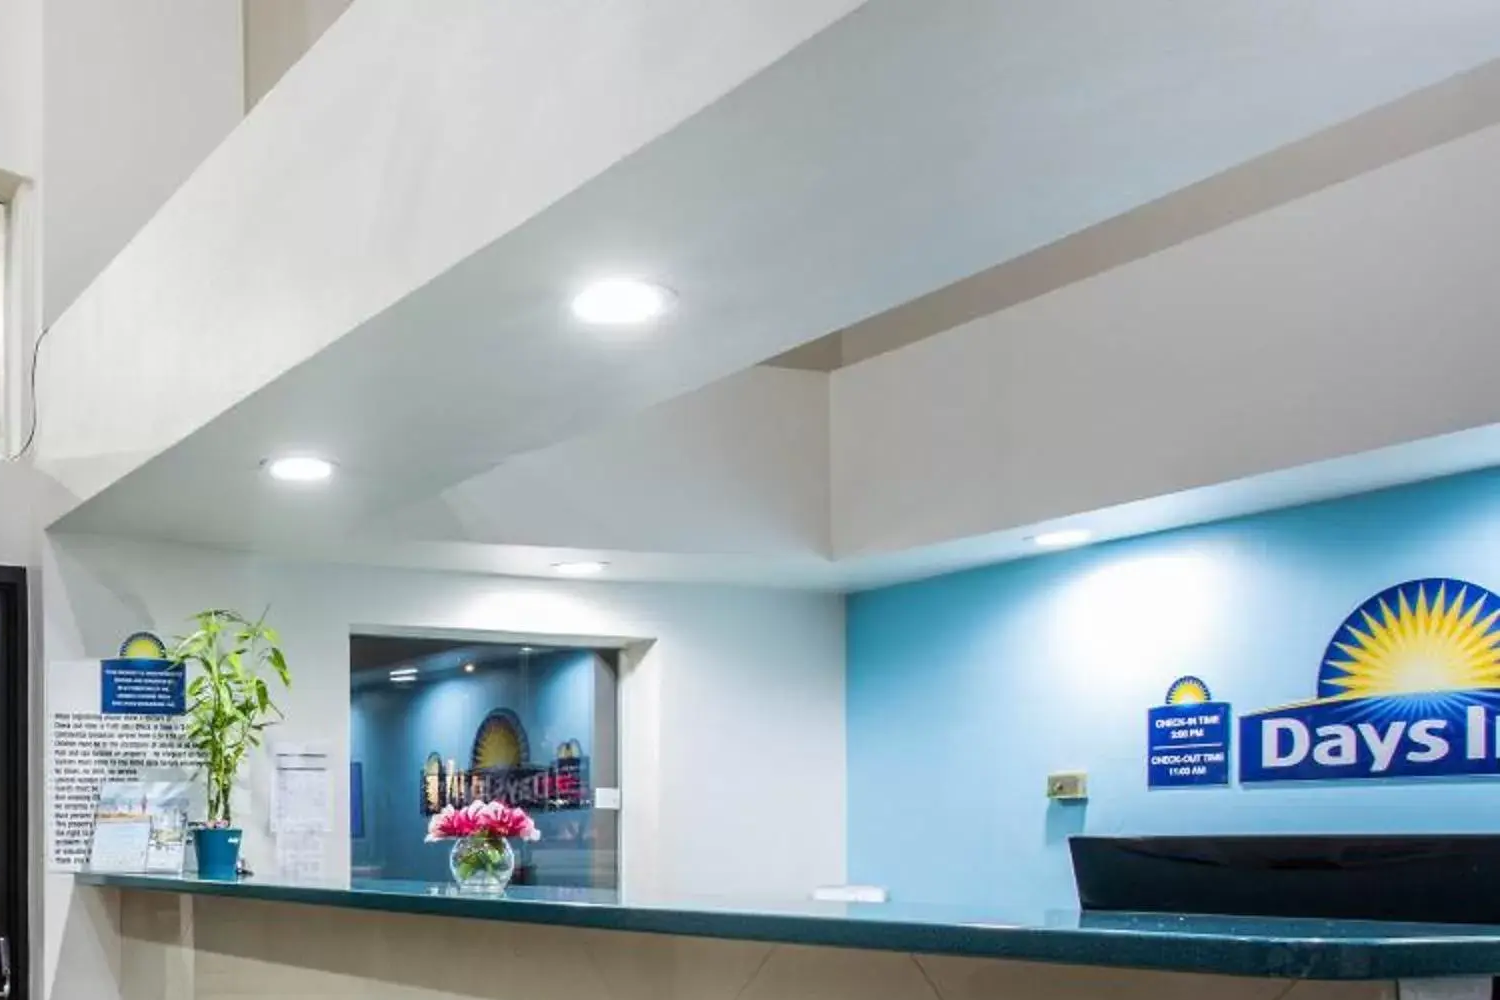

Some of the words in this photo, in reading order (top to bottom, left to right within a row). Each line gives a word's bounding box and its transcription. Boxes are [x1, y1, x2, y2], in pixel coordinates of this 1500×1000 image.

[1155, 717, 1197, 728] CHECK-IN
[1198, 715, 1221, 725] TIME
[1261, 718, 1450, 772] Days
[1467, 705, 1500, 760] I
[1151, 754, 1201, 765] CHECK-OUT
